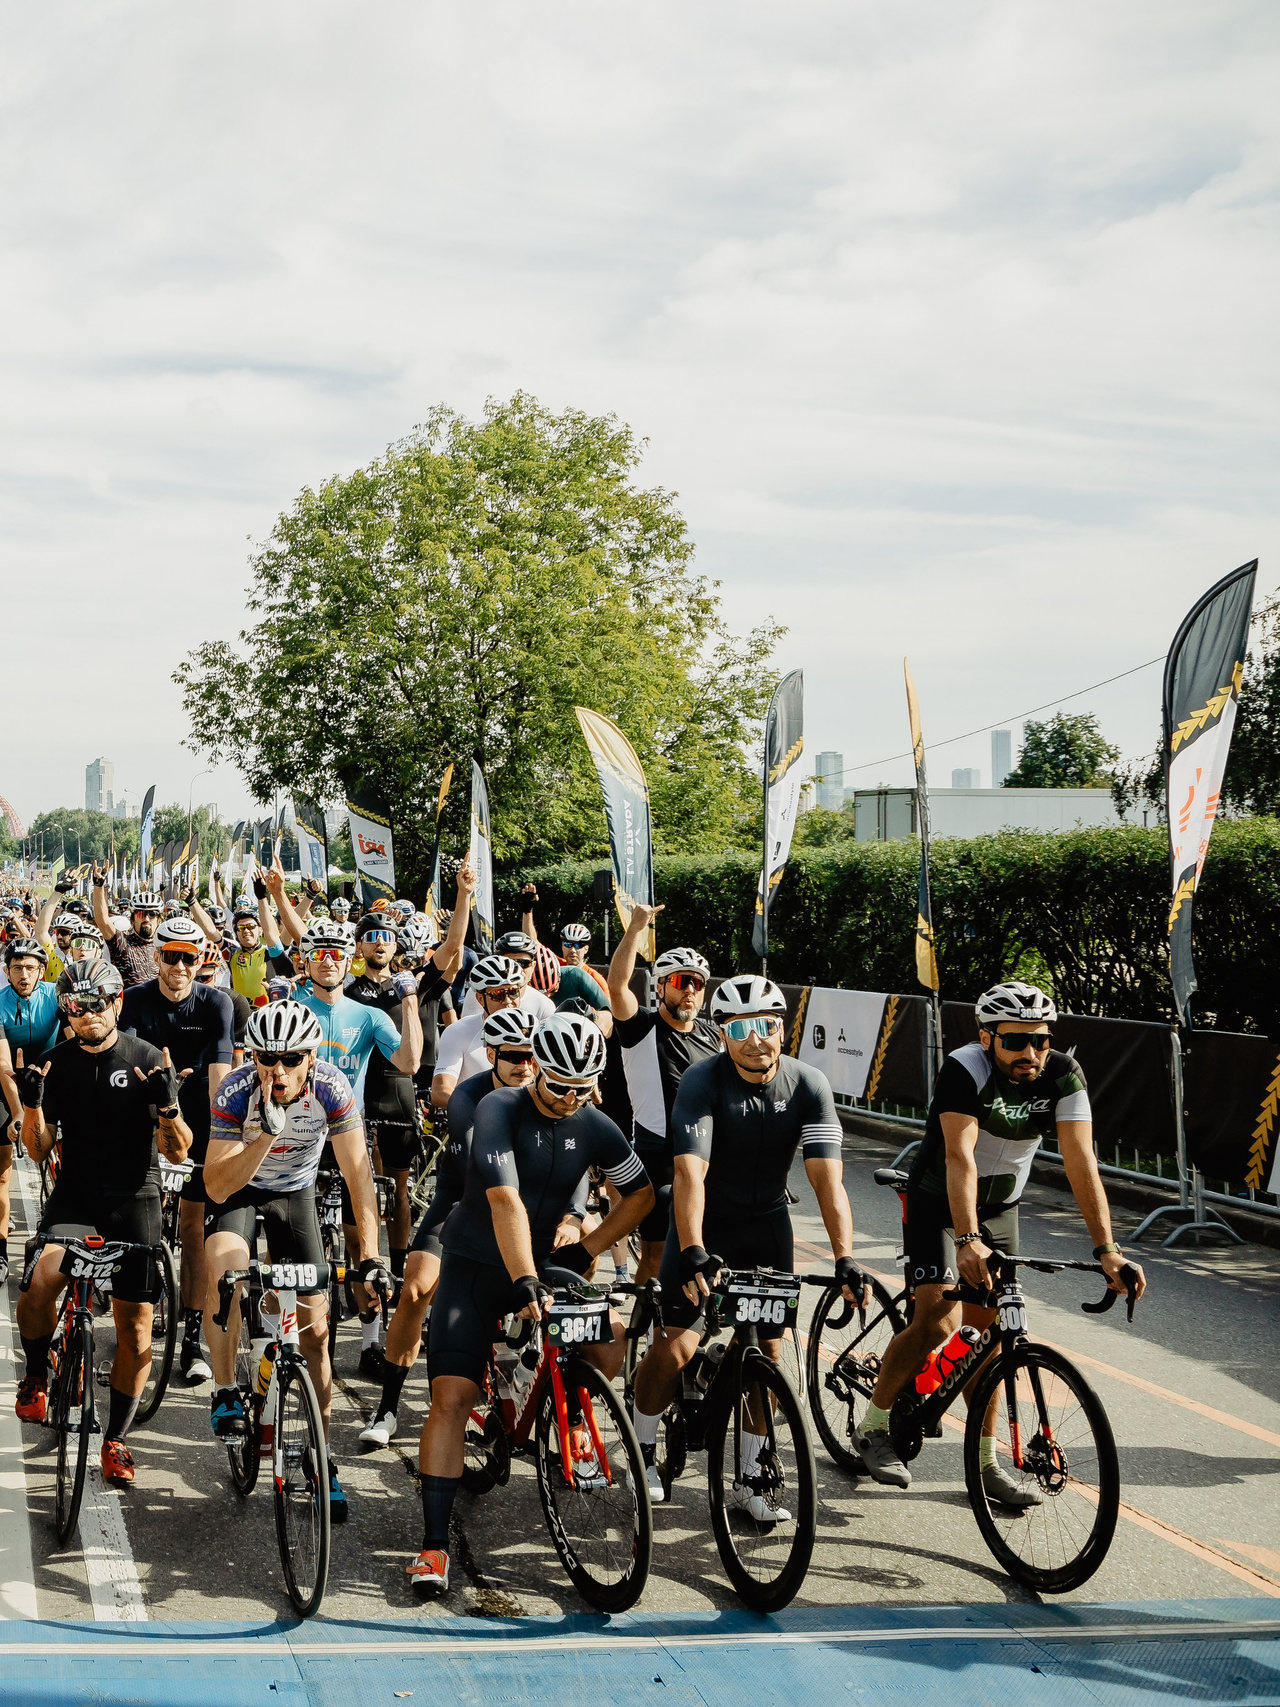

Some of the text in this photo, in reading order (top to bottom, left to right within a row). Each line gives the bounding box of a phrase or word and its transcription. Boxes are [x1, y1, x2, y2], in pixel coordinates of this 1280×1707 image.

[72, 980, 91, 991] 3472
[265, 1041, 286, 1051] 3319
[225, 1072, 255, 1098] GIAN
[71, 1258, 114, 1278] 3472
[272, 1264, 318, 1287] 3319
[736, 1297, 786, 1324] 3646
[1000, 1306, 1028, 1331] 300
[561, 1316, 602, 1343] 3647
[937, 1328, 991, 1398] COLNAGO
